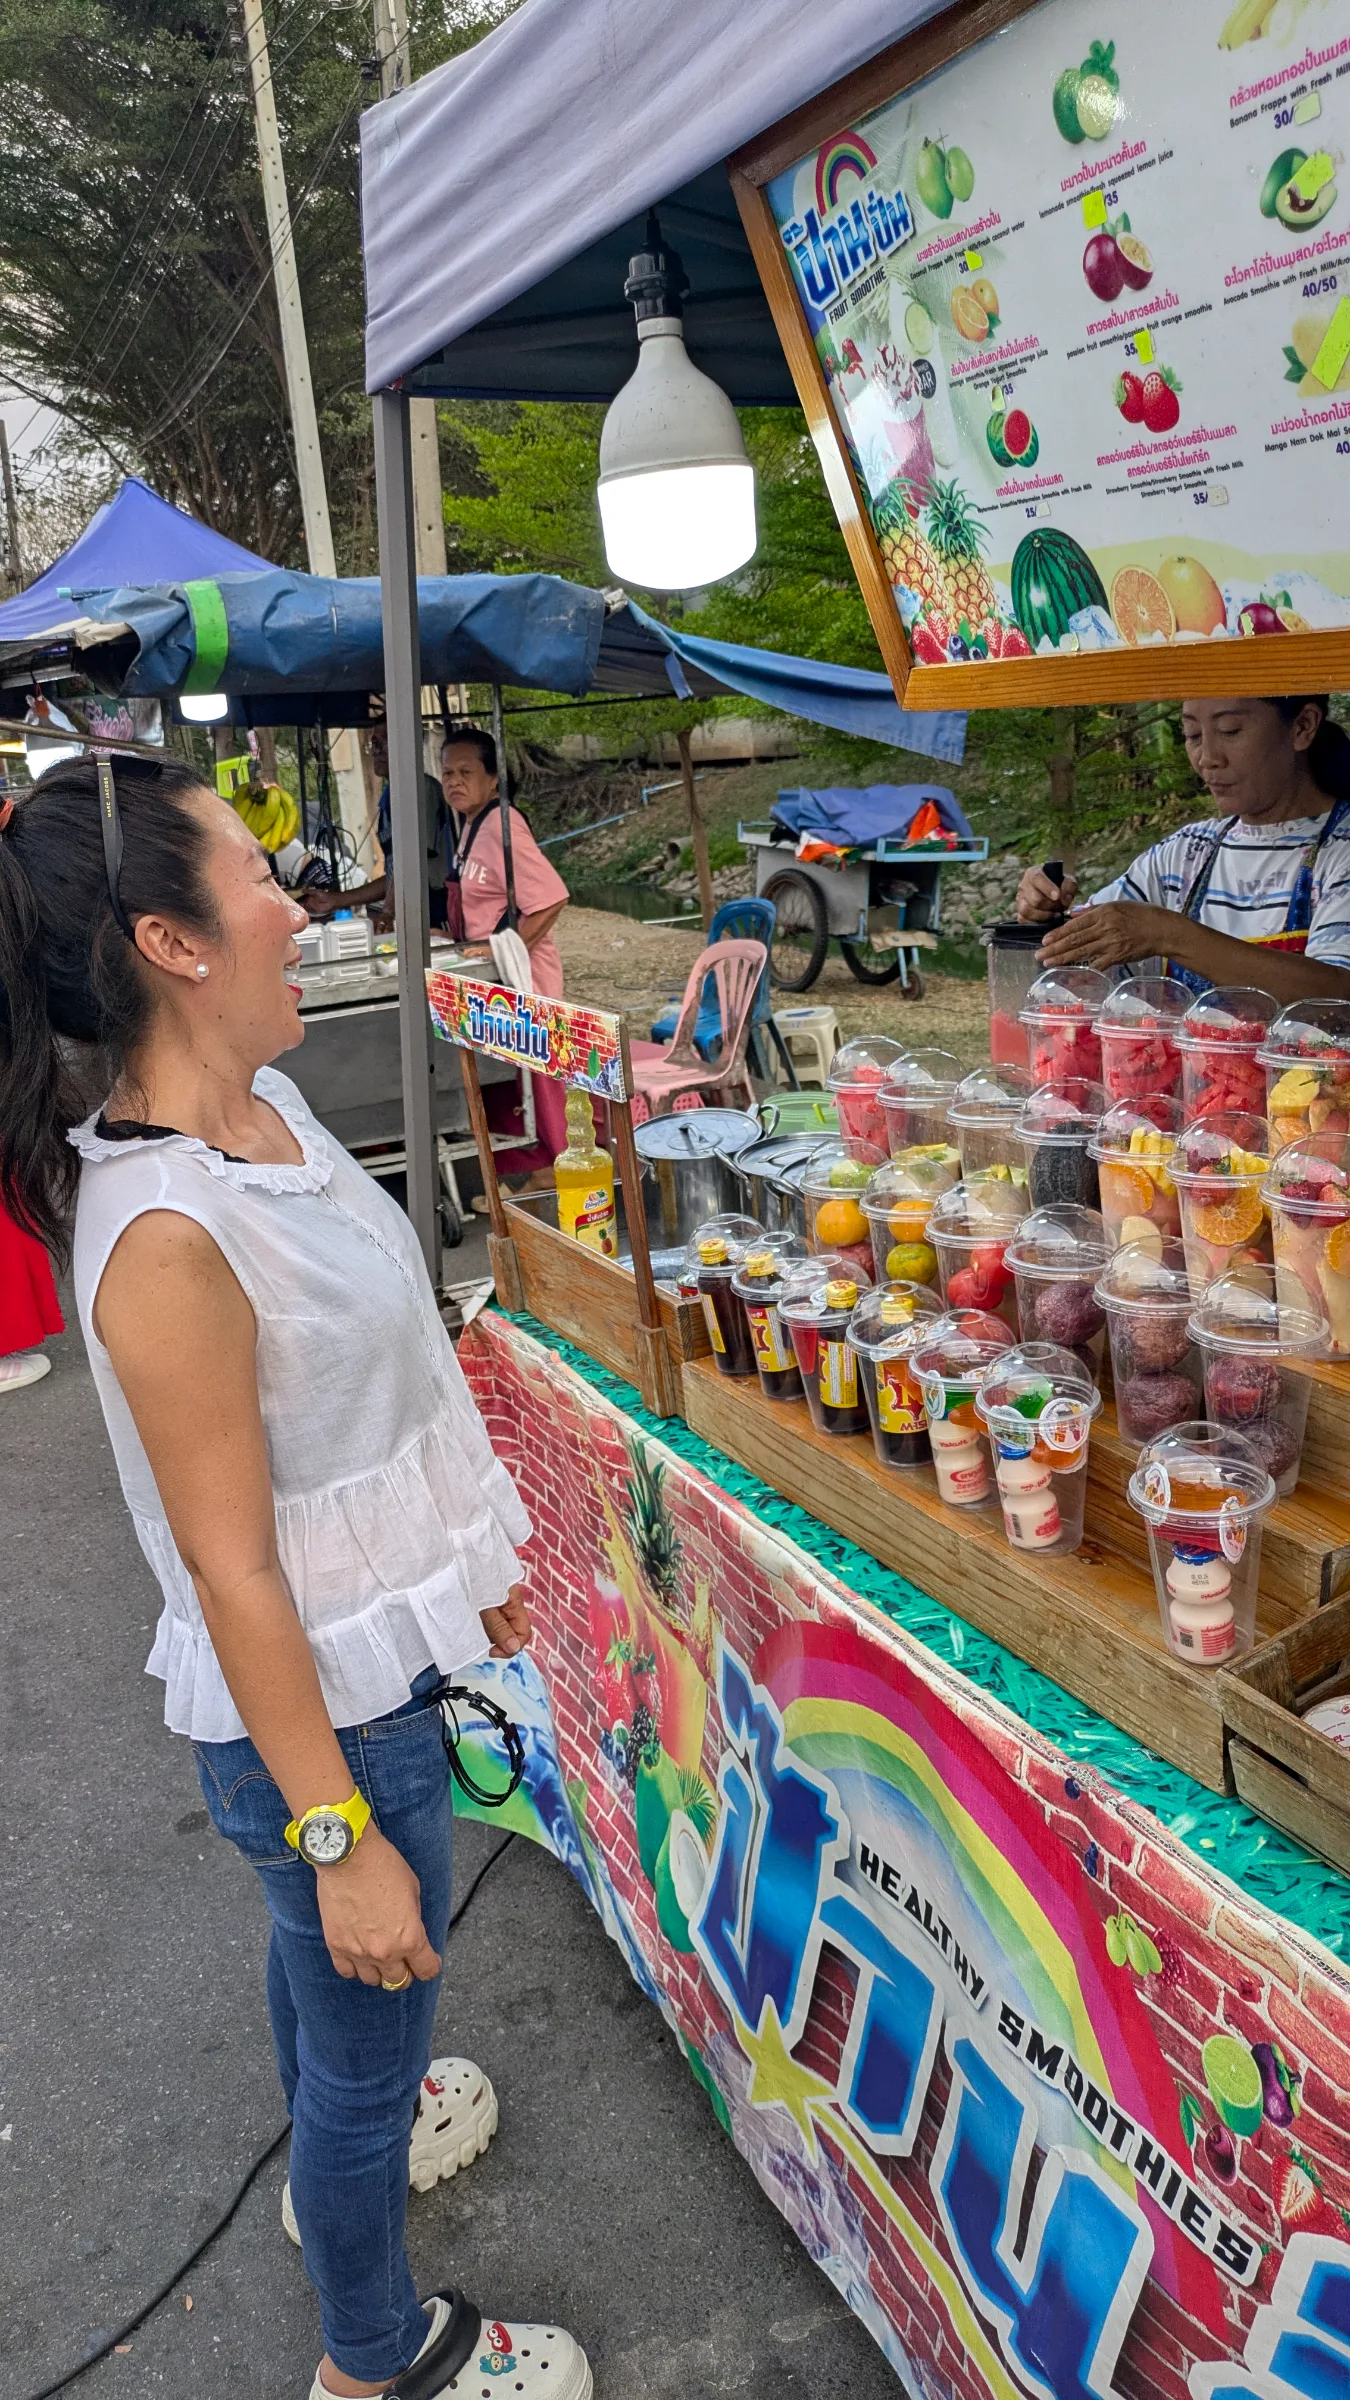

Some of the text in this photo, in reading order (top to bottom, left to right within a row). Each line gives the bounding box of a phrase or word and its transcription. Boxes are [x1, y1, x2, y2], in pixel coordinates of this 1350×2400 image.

[1229, 37, 1350, 109] กล้วยหอมทองปั่นนมส
[1229, 62, 1350, 129] Banana Frappe with Fresh Mil
[1107, 167, 1135, 187] squeezed
[1137, 159, 1156, 173] lemon
[1158, 149, 1174, 164] juice
[910, 266, 927, 280] Coconut
[928, 260, 943, 272] Frappe
[992, 227, 1010, 241] coconut
[1011, 221, 1025, 232] water
[1224, 228, 1350, 287] อะโวคาโด้ปั่นนมสด/อะโวคา
[828, 265, 887, 325] FRUIT SMOOTHIE
[1223, 256, 1350, 306] Avocado Smoothie with Fresh Milk/Avo
[1302, 275, 1337, 298] 40/50
[1066, 347, 1085, 360] passion
[1086, 341, 1098, 351] fruit
[1147, 320, 1159, 331] fruit
[1161, 314, 1182, 326] orange
[1184, 303, 1213, 319] smoothie
[973, 380, 990, 390] Orange
[1006, 367, 1027, 379] Smoothie
[1264, 441, 1288, 452] Mango
[1289, 437, 1307, 446] Nam
[1309, 432, 1324, 442] Dok
[1326, 428, 1341, 438] Mai
[1270, 402, 1350, 435] มะม่วงน้ำดอกไม้
[1041, 490, 1060, 500] Smoothie
[1061, 488, 1070, 496] with
[1105, 484, 1129, 495] Strawberry
[1178, 469, 1202, 480] Smoothie
[1203, 466, 1214, 475] with
[1216, 463, 1230, 473] Fresh
[1231, 460, 1244, 469] Milk
[1140, 479, 1207, 498] Strawberry Yogurt Smoothie
[938, 1439, 969, 1447] Yakult
[860, 1842, 986, 2001] HEALTHY
[998, 2000, 1254, 2277] SMOOTHIES
